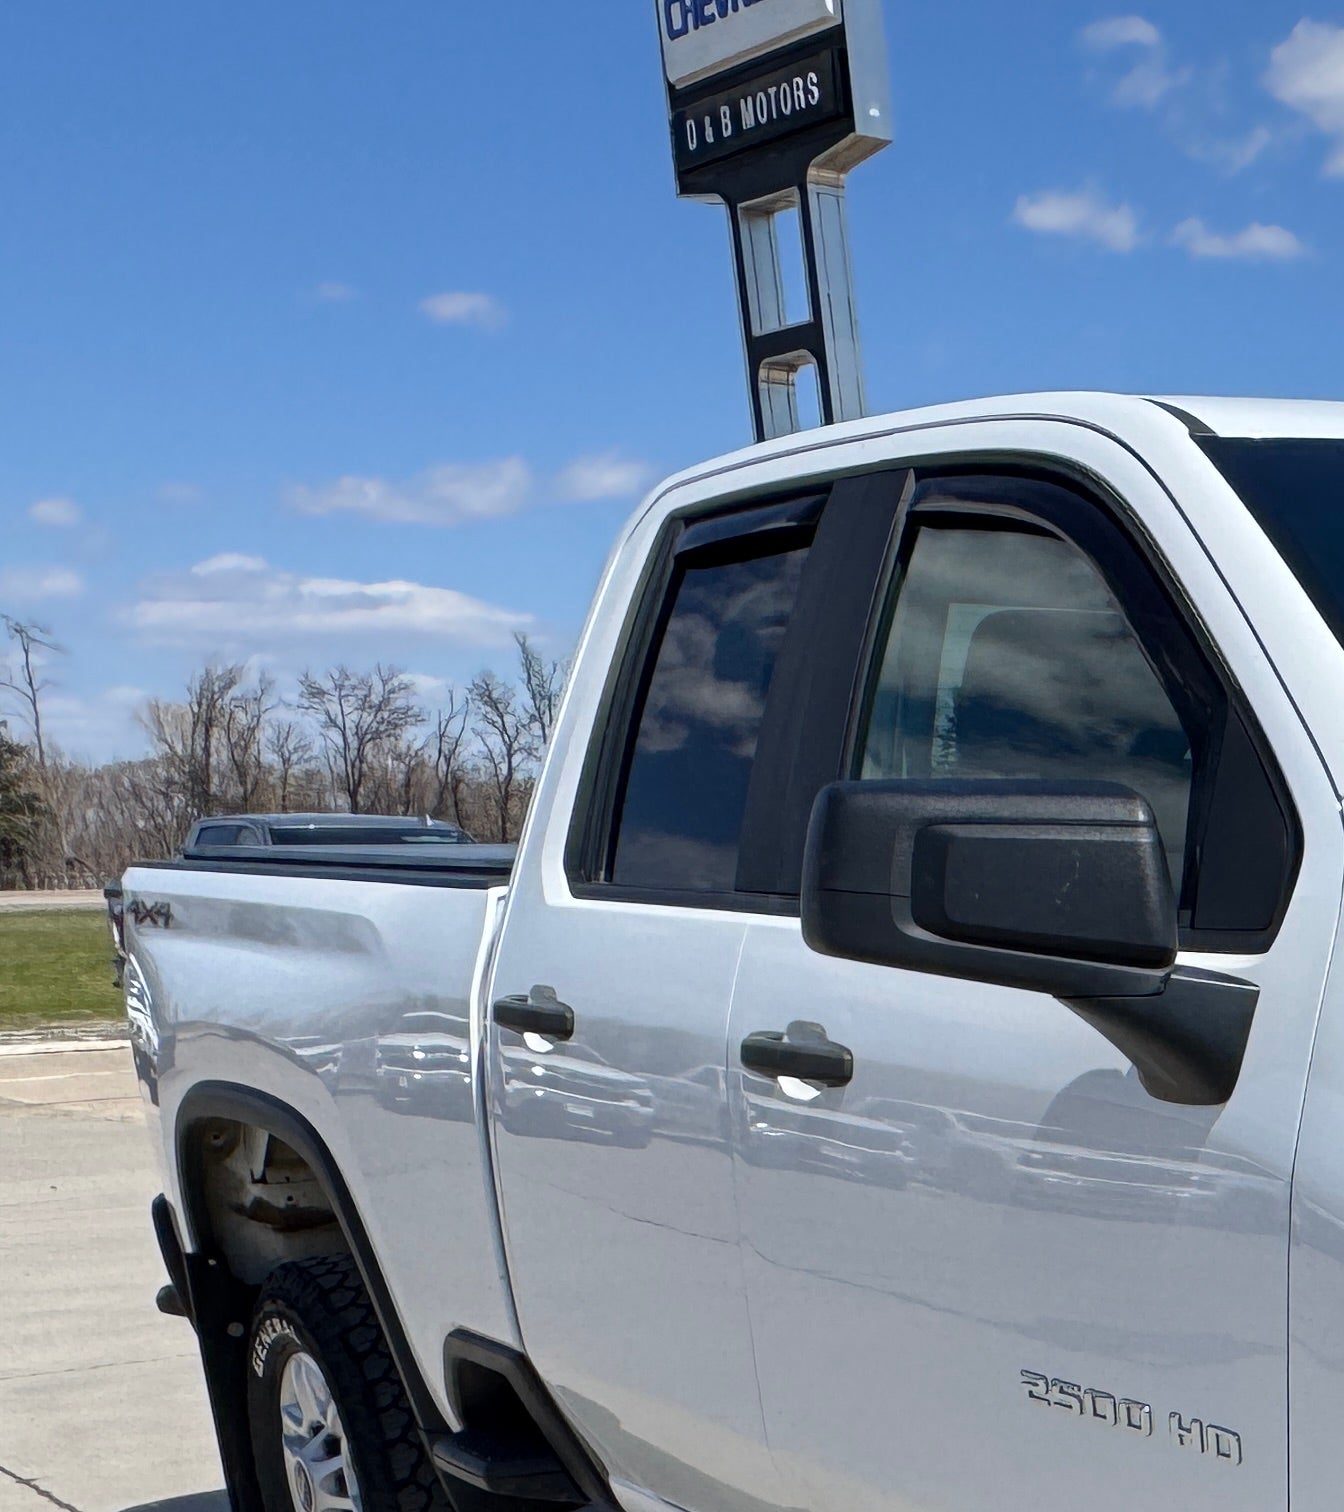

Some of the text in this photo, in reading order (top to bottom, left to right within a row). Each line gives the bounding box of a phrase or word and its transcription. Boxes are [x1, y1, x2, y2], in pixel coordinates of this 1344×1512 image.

[685, 71, 820, 152] D & B MOTORS
[1020, 1369, 1243, 1467] 2500 HD
